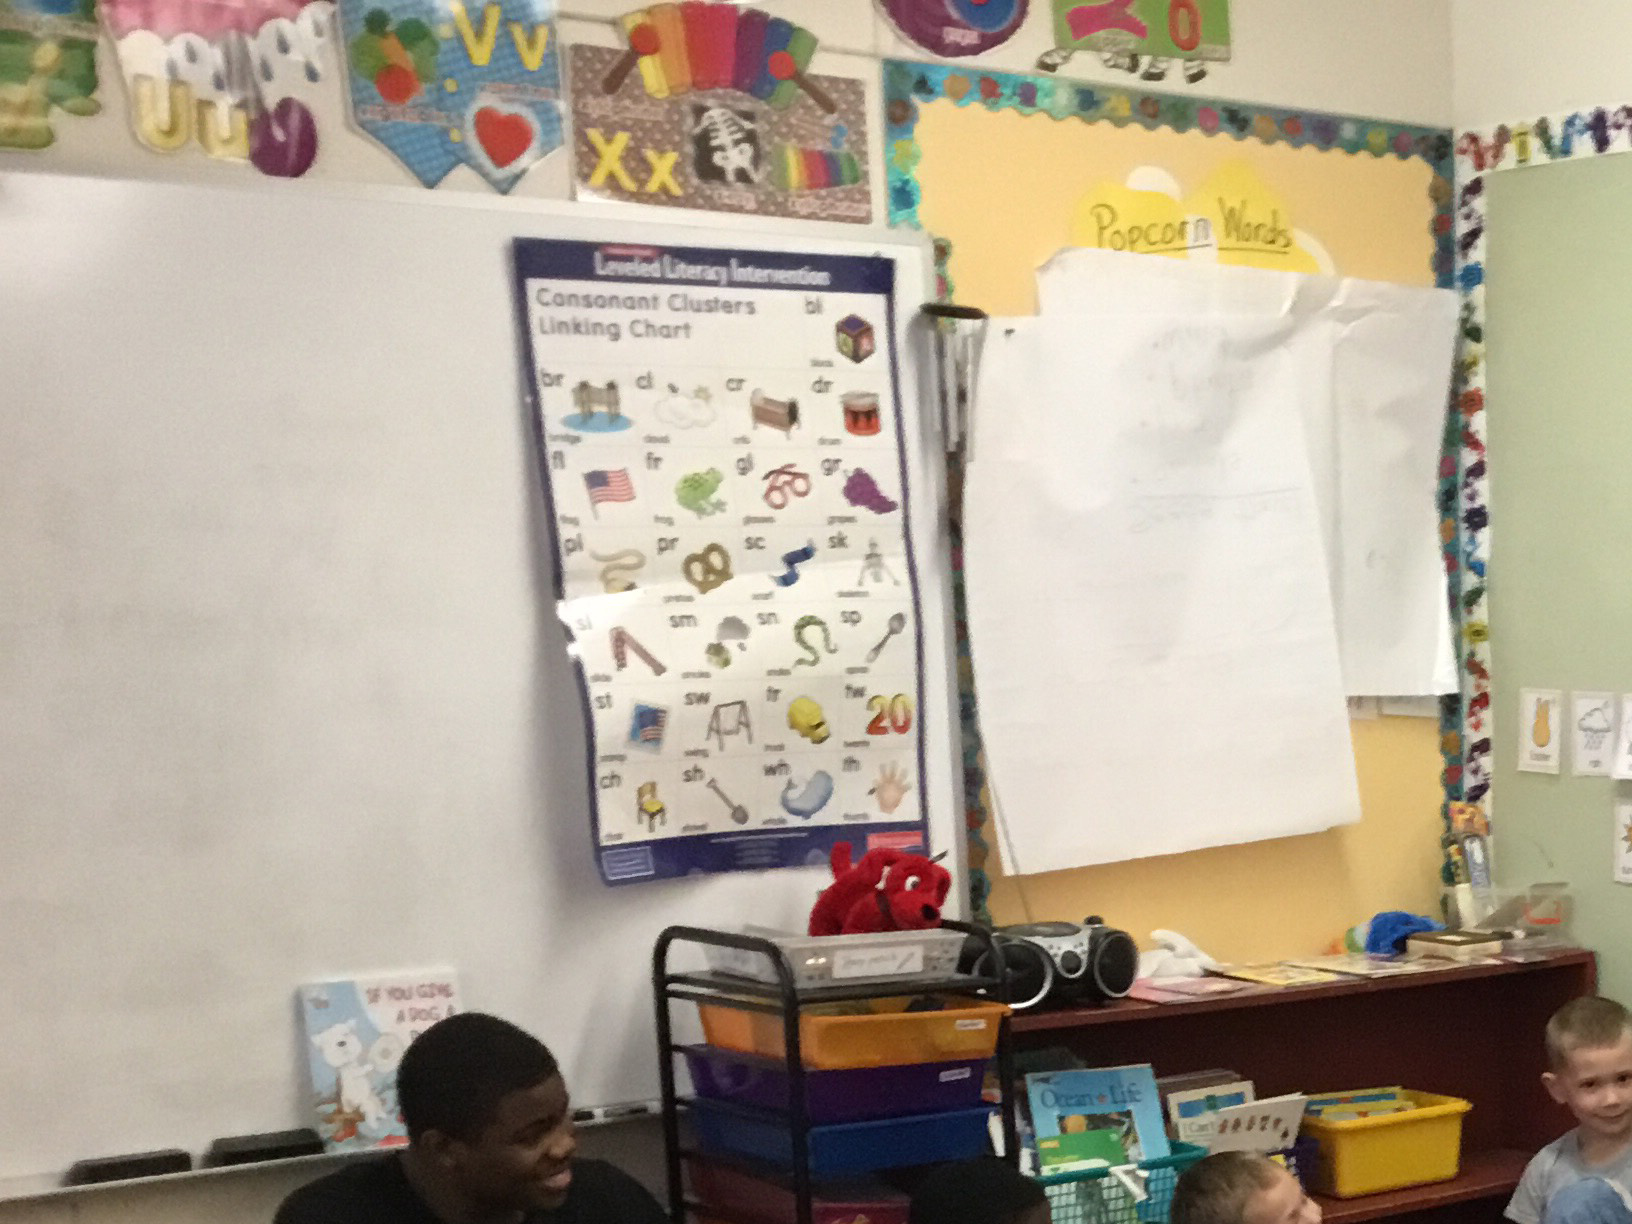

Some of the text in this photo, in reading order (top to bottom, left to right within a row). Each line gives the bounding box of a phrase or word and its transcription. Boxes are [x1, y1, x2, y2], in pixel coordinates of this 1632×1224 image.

[586, 127, 684, 198] Xx
[1090, 197, 1293, 252] Popcorn Words
[535, 286, 756, 316] Consonant Clusters
[538, 315, 692, 342] Linking Chart
[866, 692, 915, 736] 20
